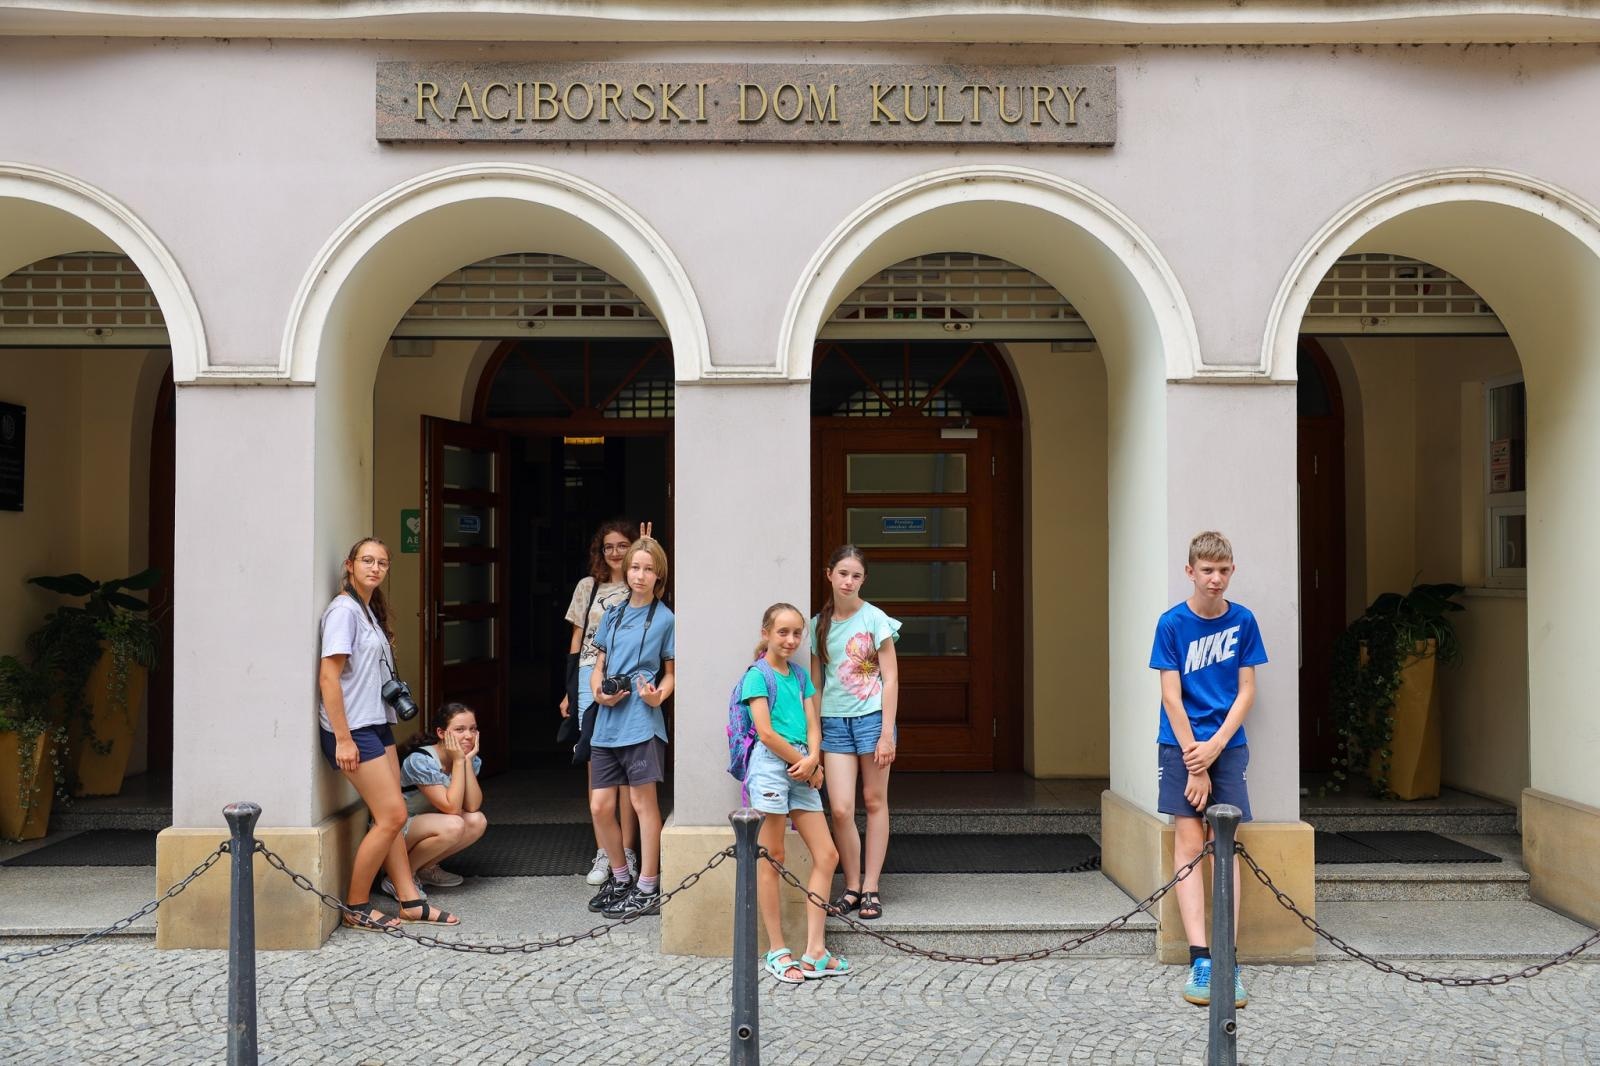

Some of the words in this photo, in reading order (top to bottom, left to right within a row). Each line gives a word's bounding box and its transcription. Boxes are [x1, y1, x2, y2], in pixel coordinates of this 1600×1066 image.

[414, 80, 707, 122] RACIBORSKI
[737, 83, 840, 123] DOM
[869, 83, 1086, 126] KULTURY
[407, 536, 420, 544] AE
[1184, 625, 1240, 675] NIKE
